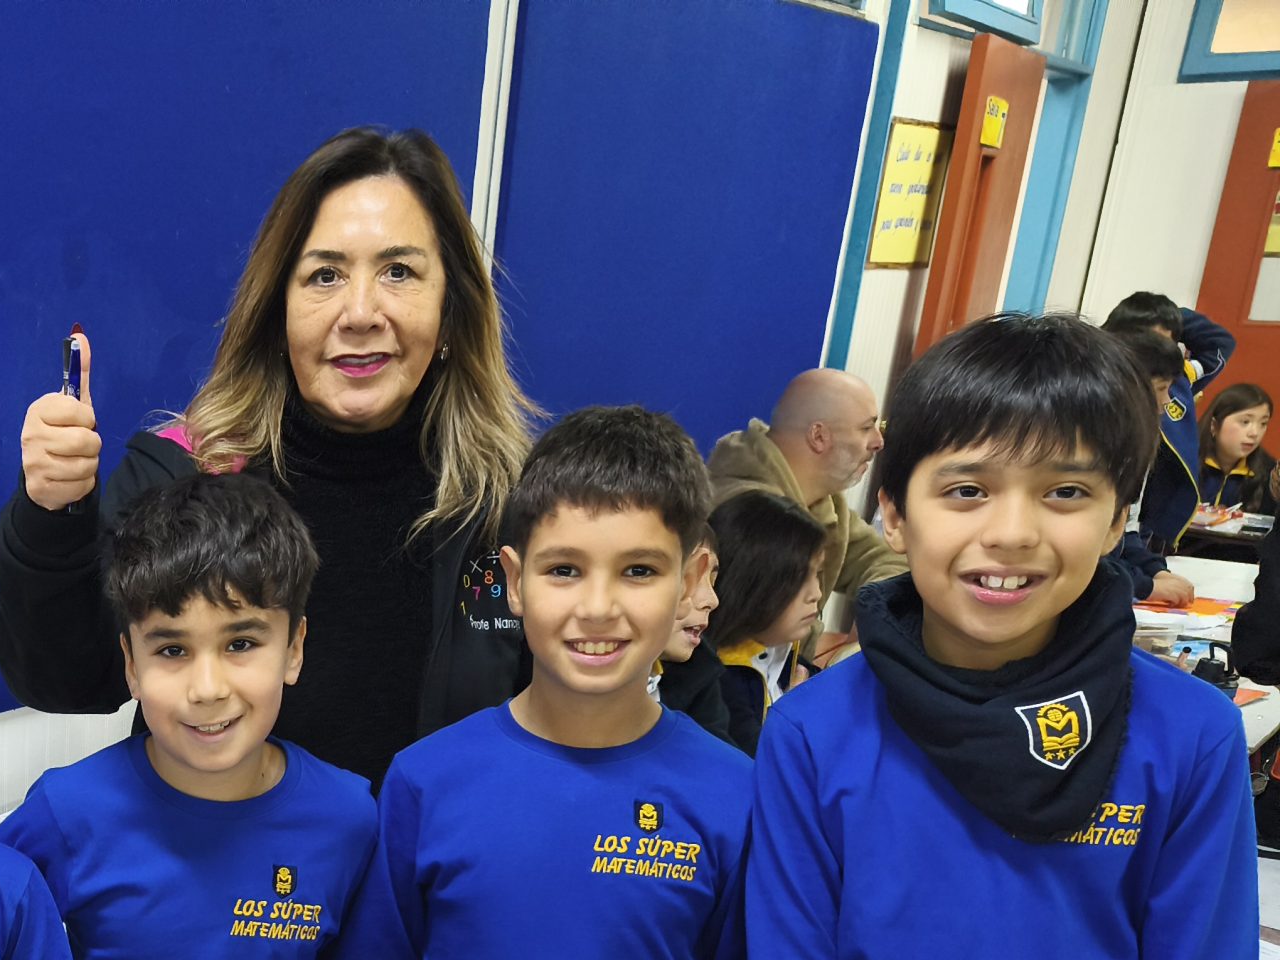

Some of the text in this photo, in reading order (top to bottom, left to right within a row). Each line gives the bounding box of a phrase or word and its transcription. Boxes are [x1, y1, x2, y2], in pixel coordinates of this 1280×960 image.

[484, 570, 494, 584] 8
[490, 584, 502, 597] 9
[1091, 802, 1146, 824] PER
[592, 833, 701, 863] LOS SÚPER
[591, 856, 698, 881] MATEMÁTICOS
[232, 897, 322, 922] LOS SÚPER
[230, 919, 321, 940] MATEMÁTICOS
